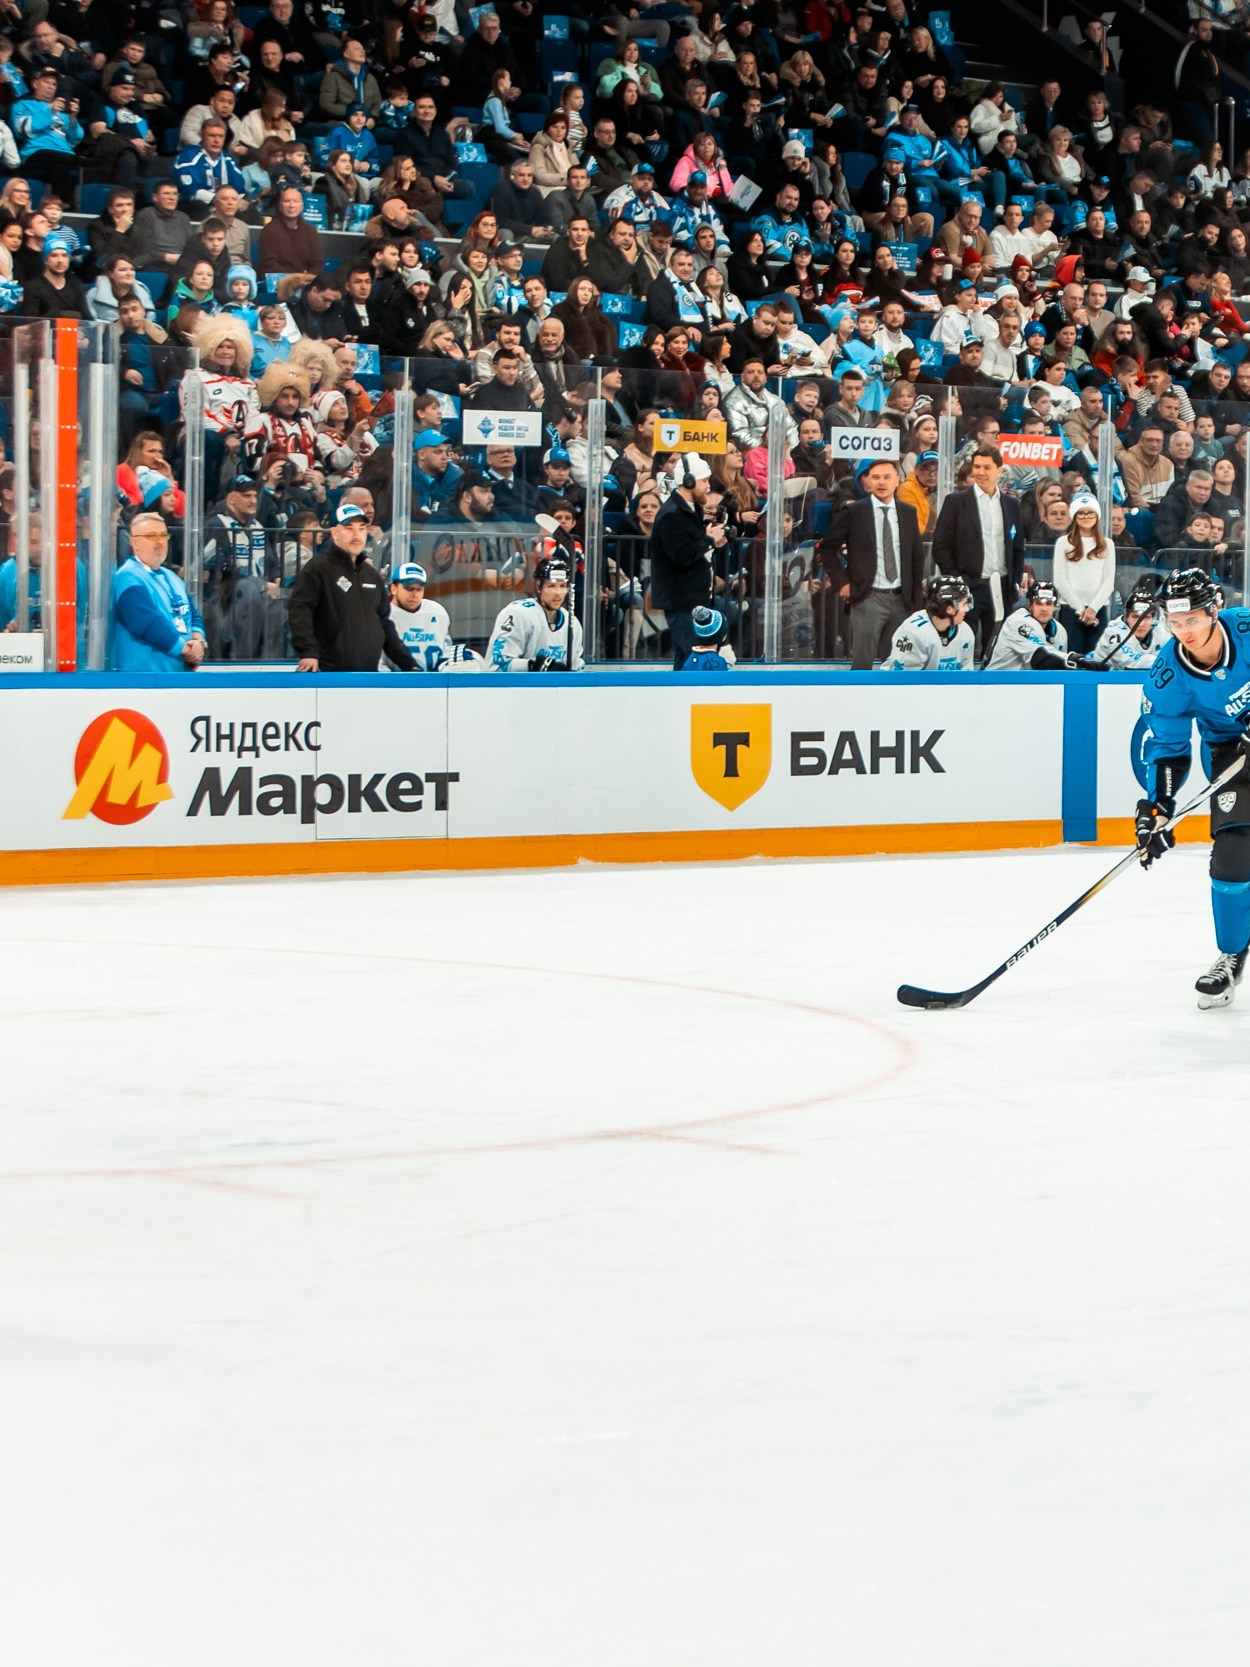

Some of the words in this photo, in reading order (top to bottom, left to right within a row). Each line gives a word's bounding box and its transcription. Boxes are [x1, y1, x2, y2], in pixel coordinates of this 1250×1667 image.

[683, 431, 719, 443] БАНК
[838, 434, 893, 452] согаз
[1000, 441, 1062, 461] FONBET
[1149, 657, 1175, 690] 89
[189, 715, 322, 758] Яндекс
[713, 731, 750, 777] Т
[790, 729, 947, 777] БАНК
[186, 766, 460, 824] Маркет
